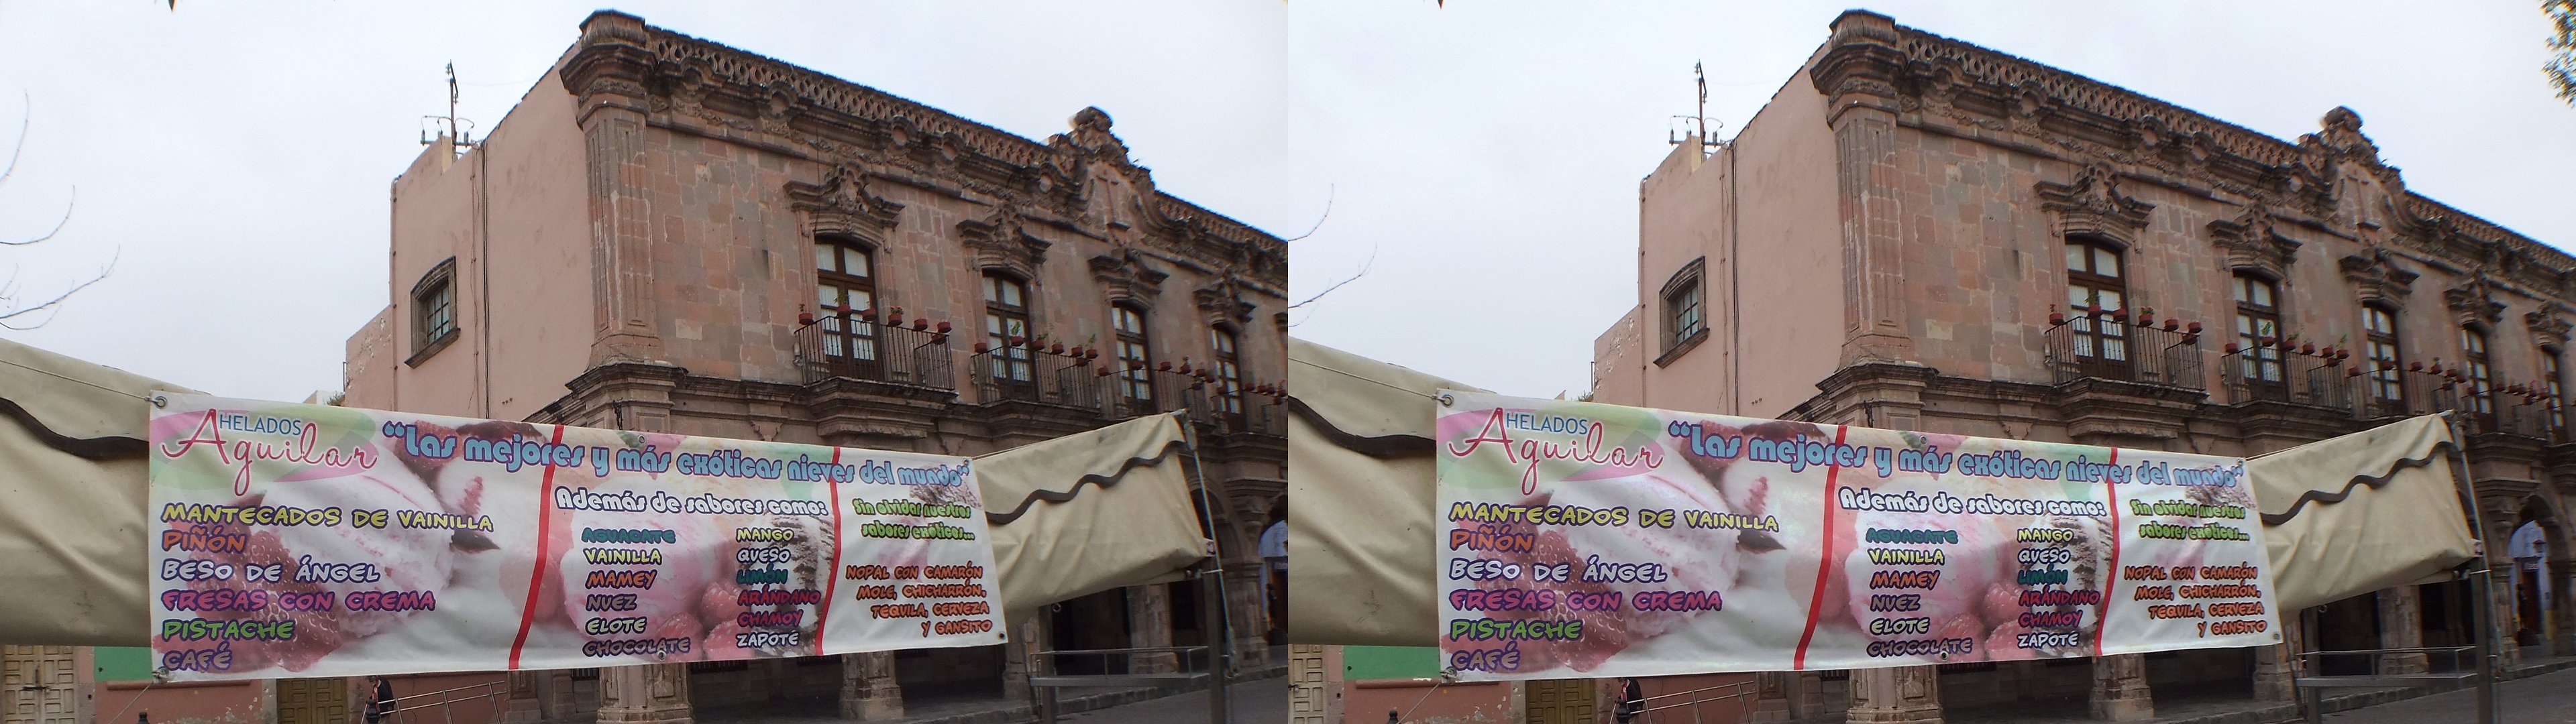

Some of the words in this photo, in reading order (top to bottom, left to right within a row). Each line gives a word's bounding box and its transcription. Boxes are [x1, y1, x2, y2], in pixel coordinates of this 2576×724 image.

[219, 414, 301, 435] HELADOS
[1505, 412, 1588, 435] HELADOS
[162, 408, 378, 496] Aguilar
[464, 433, 585, 473] mejores
[592, 446, 609, 477] y
[616, 444, 670, 473] más
[676, 449, 782, 479] exóticas
[788, 455, 855, 483] nieves
[859, 461, 892, 485] del
[1448, 406, 1664, 496] Aguilar
[1749, 433, 1868, 473] mejores
[1874, 446, 1892, 479] y
[1899, 445, 1952, 474] más
[1957, 449, 2061, 479] exóticas
[2066, 455, 2133, 485] nieves
[2136, 460, 2171, 486] del
[555, 486, 647, 513] Además
[650, 491, 682, 514] de
[685, 493, 765, 516] sabores
[766, 499, 828, 516] como:
[852, 498, 875, 516] Sin
[875, 499, 921, 517] olvidar
[922, 503, 971, 519] nuestros
[1838, 486, 1929, 513] Además
[1932, 491, 1964, 515] de
[1966, 494, 2045, 516] sabores
[2046, 499, 2107, 517] como:
[2129, 499, 2153, 516] Sin
[2153, 499, 2197, 518] olvidar
[2199, 503, 2246, 520] nuestros
[161, 502, 342, 528] MANTECADOS
[352, 509, 389, 529] DE
[397, 509, 495, 534] VAINILLA
[1448, 501, 1629, 528] MANTECADOS
[1639, 507, 1675, 529] DE
[1684, 509, 1780, 534] VAINILLA
[161, 524, 248, 554] PIÑÓN
[581, 528, 676, 544] AGUACATE
[736, 528, 794, 543] MANGO
[861, 520, 910, 539] sabores
[1449, 523, 1535, 554] PIÑÓN
[1866, 528, 1959, 544] AGUACATE
[2017, 528, 2074, 544] MANGO
[2139, 520, 2186, 540] sabores
[583, 548, 662, 565] VAINILLA
[736, 546, 791, 564] QUESO
[1867, 548, 1945, 566] VAINILLA
[2017, 547, 2071, 565] QUESO
[160, 558, 233, 582] BESO
[246, 562, 282, 583] DE
[295, 555, 381, 584] ÁNGEL
[736, 563, 788, 585] LIMÓN
[845, 564, 890, 580] NOPAL
[894, 566, 919, 580] CON
[923, 560, 983, 580] CAMARÓN
[1449, 558, 1521, 582] BESO
[1533, 562, 1569, 583] DE
[1583, 554, 1668, 584] ÁNGEL
[2017, 563, 2068, 585] LIMÓN
[2124, 565, 2167, 581] NOPAL
[2171, 566, 2196, 580] CON
[2200, 561, 2257, 580] CAMARÓN
[585, 570, 657, 589] MAMEY
[1870, 570, 1940, 589] MAMEY
[161, 589, 268, 612] FRESAS
[278, 590, 335, 612] CON
[344, 590, 437, 612] CREMA
[586, 594, 637, 611] NUEZ
[737, 584, 821, 606] ARÁNDANO
[856, 585, 898, 600] MOLE,
[1449, 589, 1555, 612] FRESAS
[1566, 590, 1622, 612] CON
[1631, 589, 1723, 613] CREMA
[2018, 585, 2100, 606] ARÁNDANO
[2134, 585, 2174, 601] MOLE,
[871, 603, 929, 619] TEQUILA,
[932, 601, 990, 616] CERVEZA
[1870, 594, 1921, 612] NUEZ
[2148, 603, 2204, 619] TEQUILA,
[2208, 601, 2265, 617] CERVEZA
[586, 617, 647, 635] ELOTE
[737, 609, 804, 628] CHAMOY
[920, 620, 930, 638] Y
[934, 619, 993, 635] GANSITO
[1870, 617, 1930, 636] ELOTE
[2018, 610, 2083, 628] CHAMOY
[2198, 621, 2207, 638] Y
[2211, 619, 2267, 636] GANSITO
[161, 618, 297, 642] PISTACHE
[736, 631, 799, 648] ZAPOTE
[1449, 618, 1584, 642] PISTACHE
[582, 638, 690, 658] CHOCOLATE
[1866, 638, 1974, 658] CHOCOLATE
[2017, 632, 2078, 649] ZAPOTE
[162, 642, 234, 672] CAFÉ
[1450, 642, 1521, 672] CAFÉ
